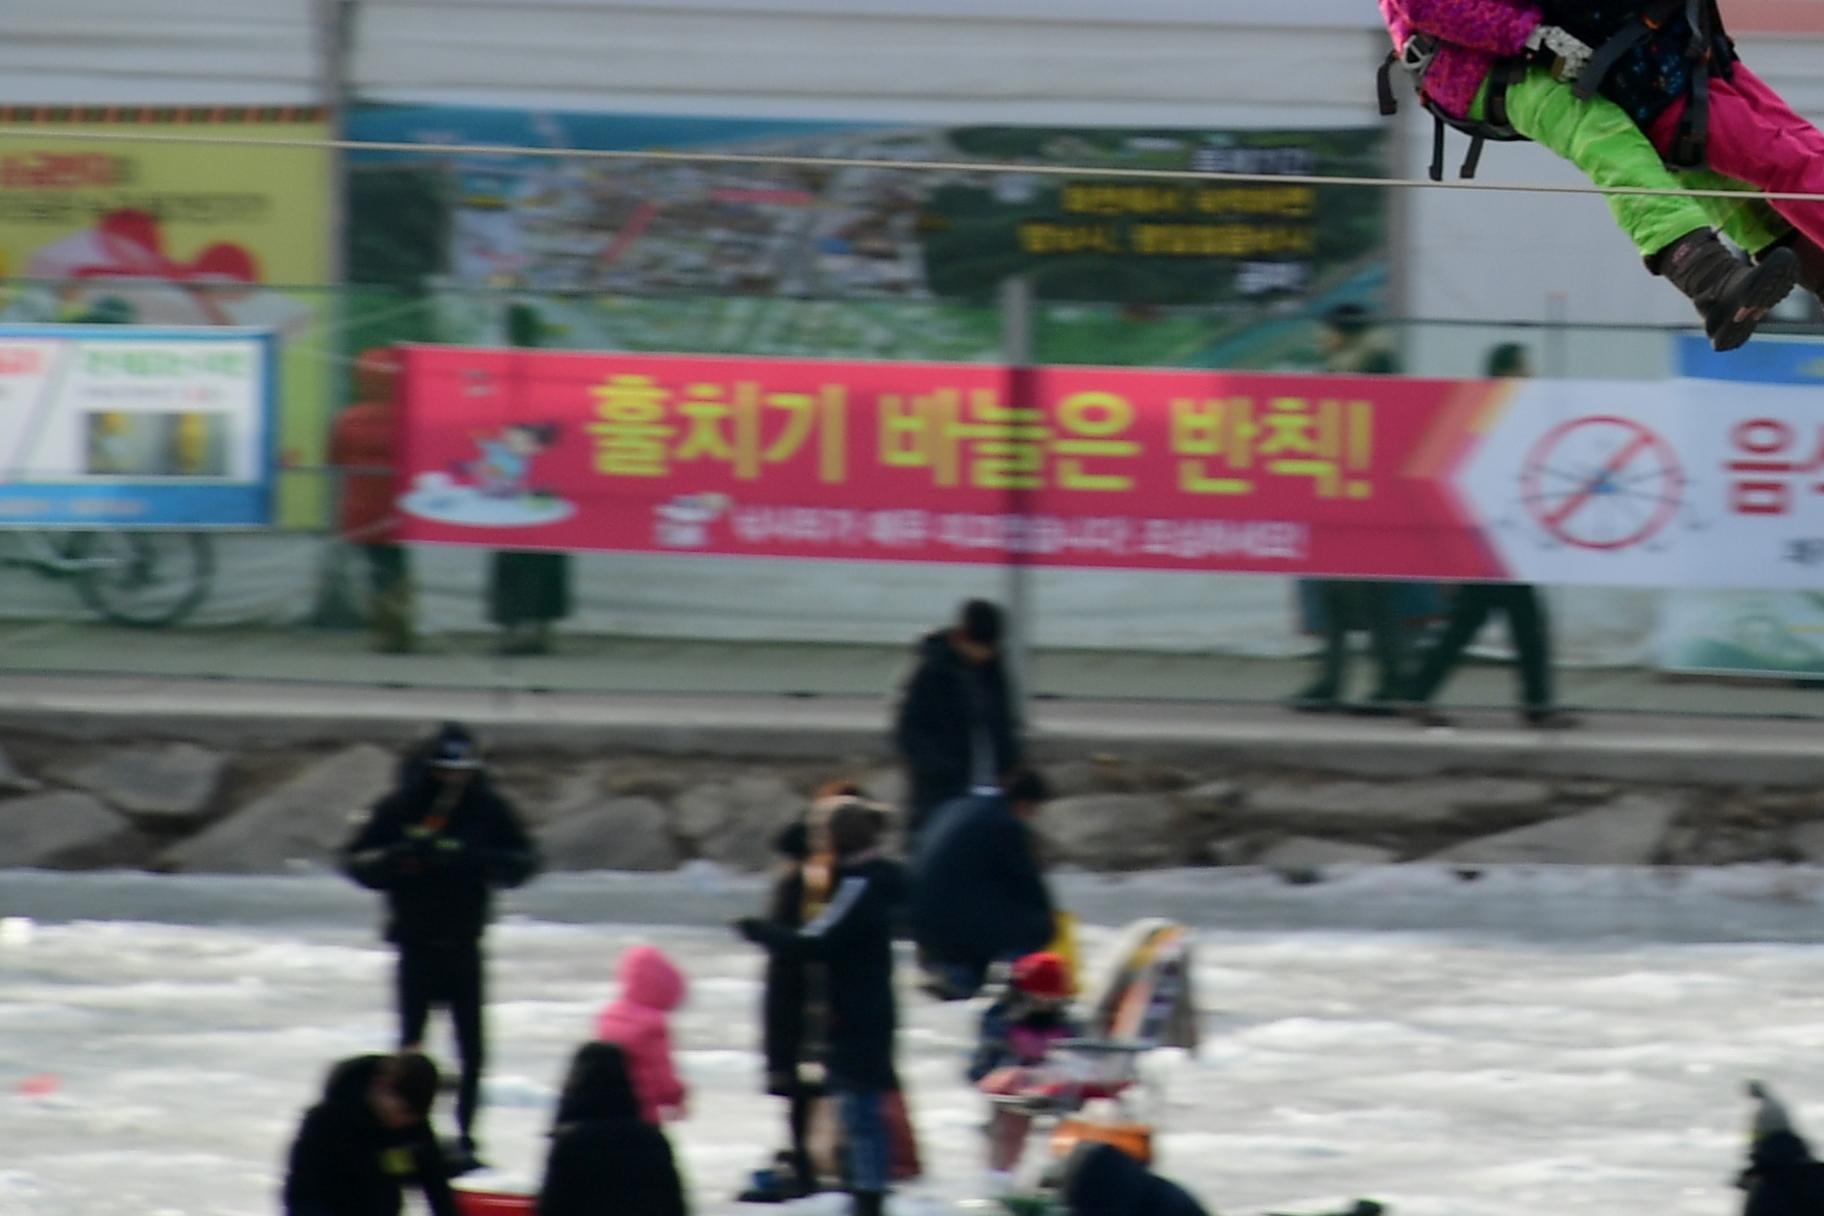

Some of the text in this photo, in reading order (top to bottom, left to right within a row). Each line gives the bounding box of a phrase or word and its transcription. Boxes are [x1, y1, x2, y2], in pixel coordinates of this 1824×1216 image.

[588, 374, 1376, 500] 훌치기 바늘은 반칙!
